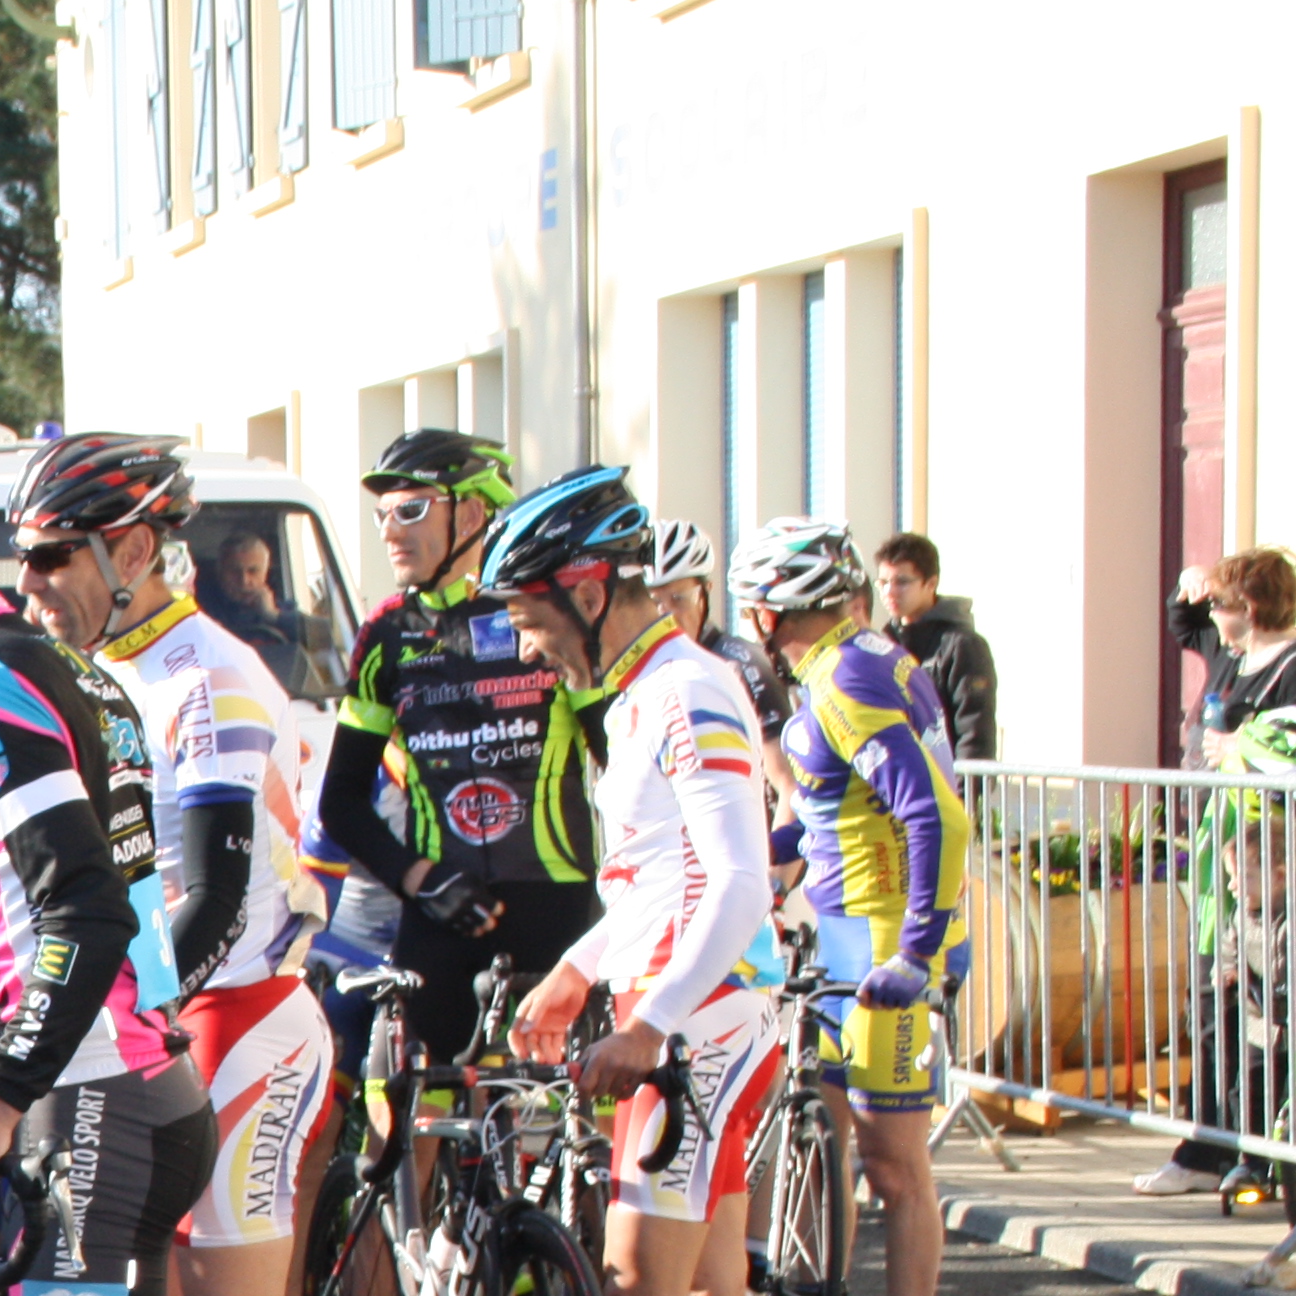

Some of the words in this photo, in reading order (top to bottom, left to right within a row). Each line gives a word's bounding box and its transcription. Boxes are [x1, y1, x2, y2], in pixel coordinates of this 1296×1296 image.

[471, 740, 543, 767] Cycles
[893, 1013, 914, 1085] SAVEURS
[72, 1086, 106, 1147] SPORT
[246, 1062, 303, 1219] MADIRAN
[68, 1150, 97, 1196] VELO
